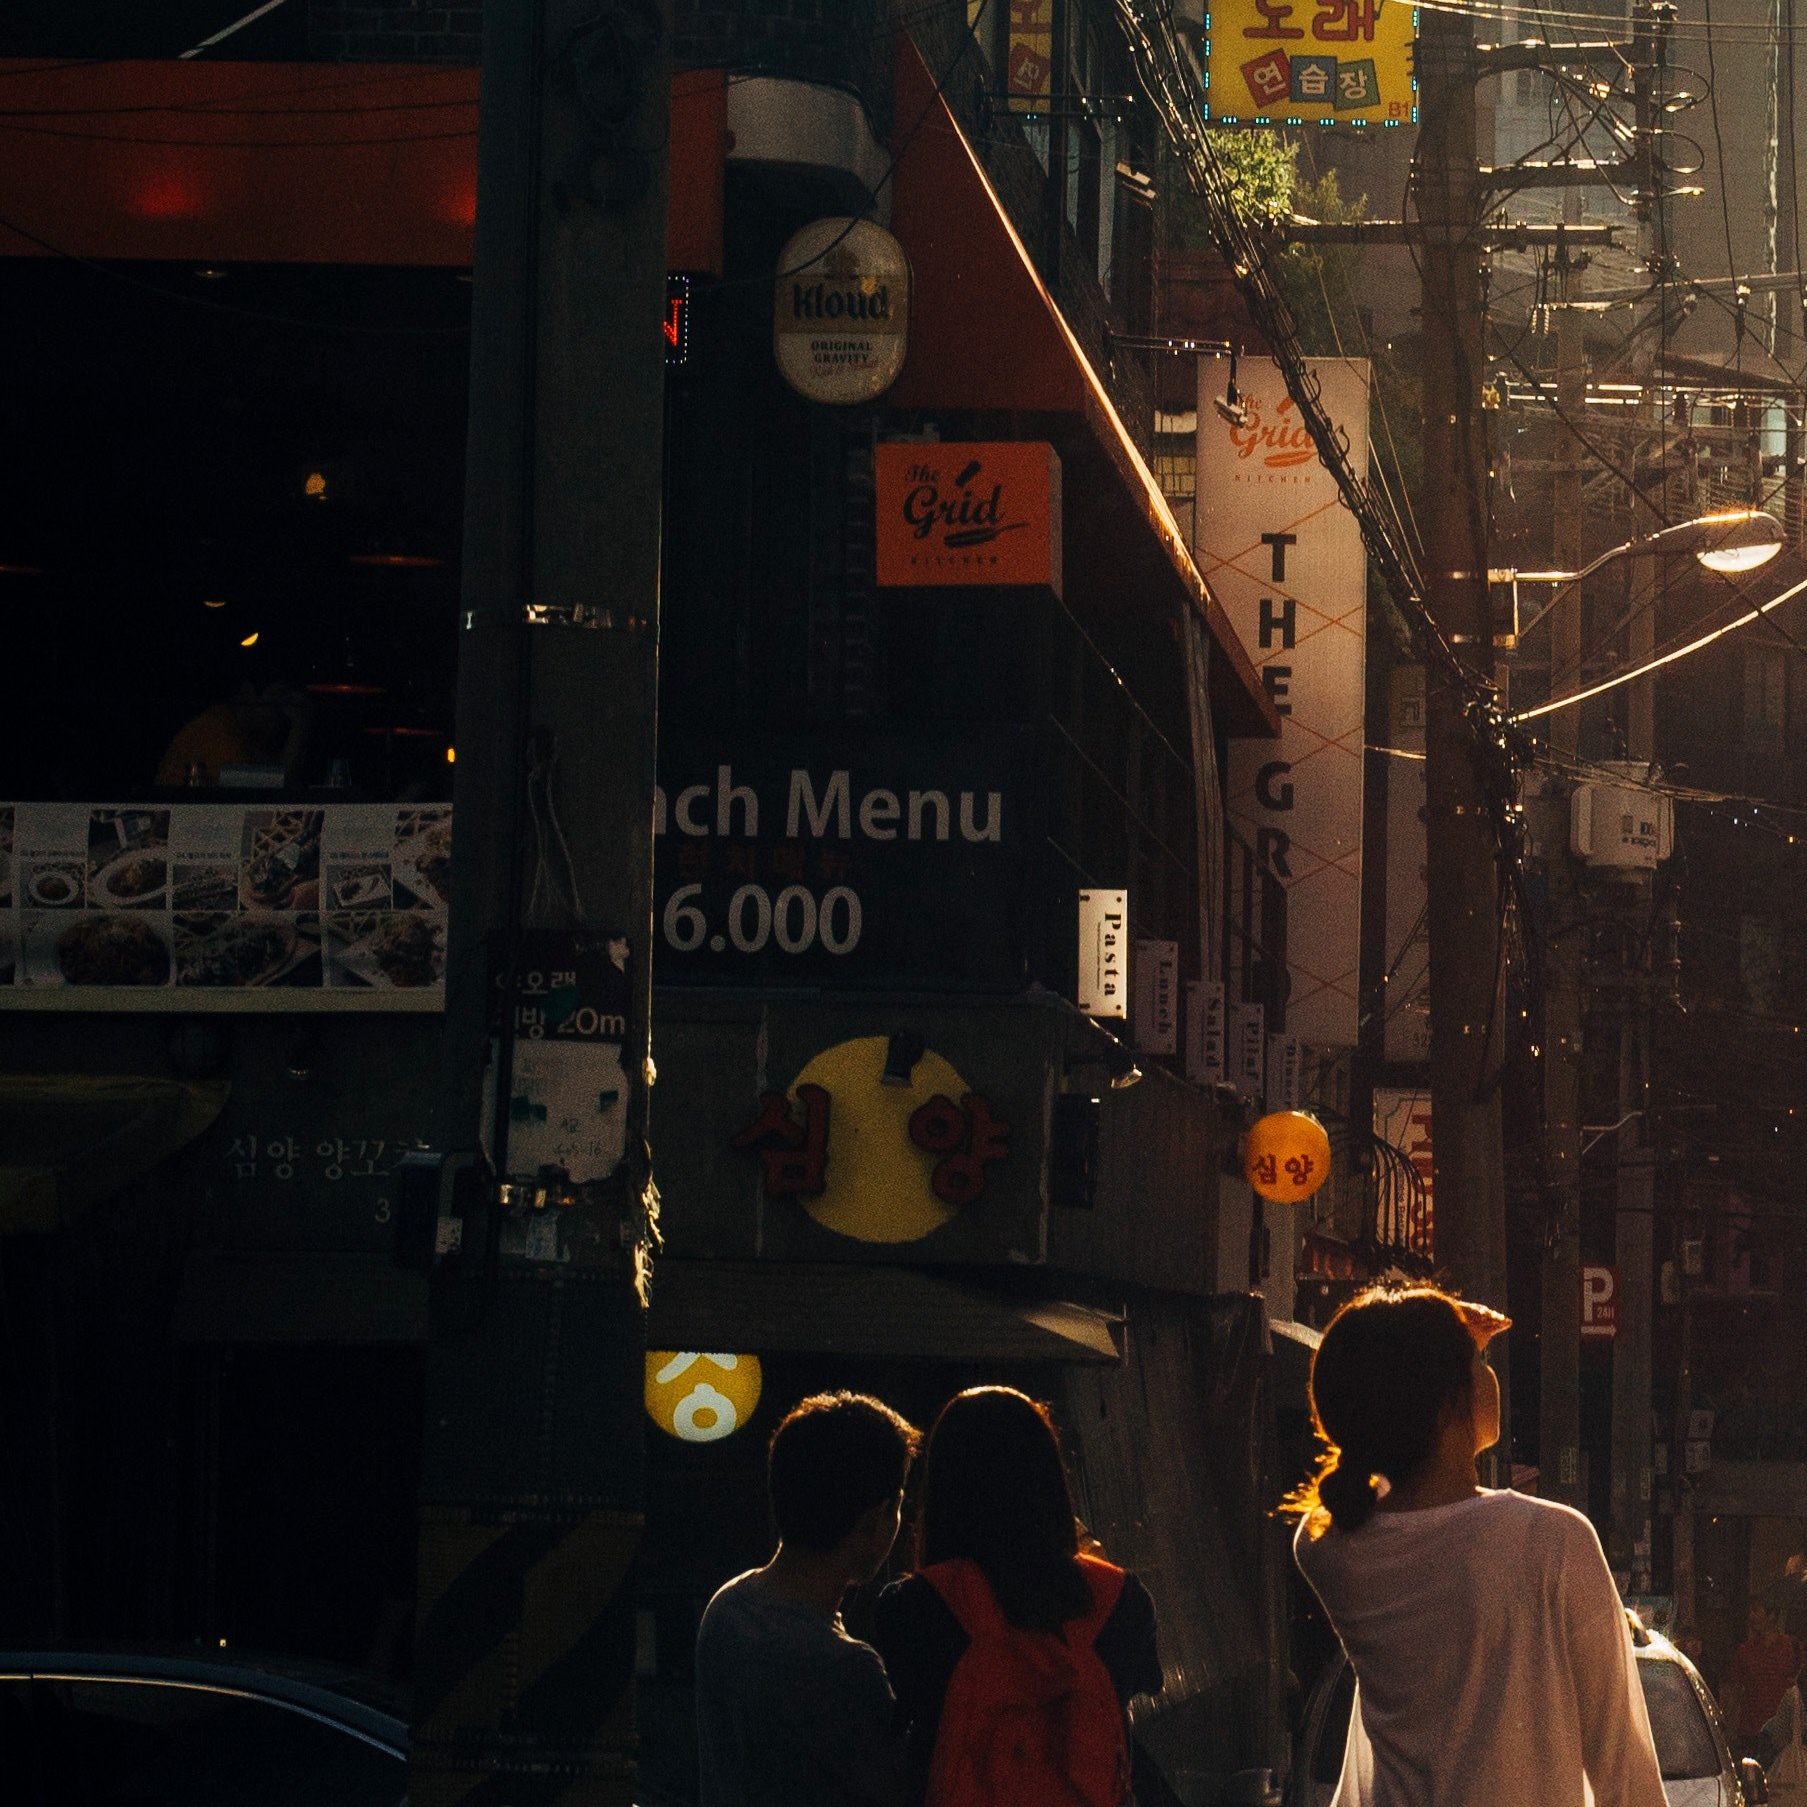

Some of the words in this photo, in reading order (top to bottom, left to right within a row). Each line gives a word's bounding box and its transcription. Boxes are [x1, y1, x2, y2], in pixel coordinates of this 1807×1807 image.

[1251, 59, 1370, 101] 연습장
[811, 339, 874, 352] ORIGINAL
[903, 484, 1007, 540] Grid
[1258, 533, 1299, 716] THE
[785, 768, 1003, 842] Menu
[663, 883, 863, 955] 6.000
[1105, 913, 1123, 997] Pasta
[226, 1135, 301, 1180] 심양
[316, 1137, 433, 1181] 양꼬
[1252, 1154, 1315, 1186] 심양
[1583, 1266, 1615, 1323] P
